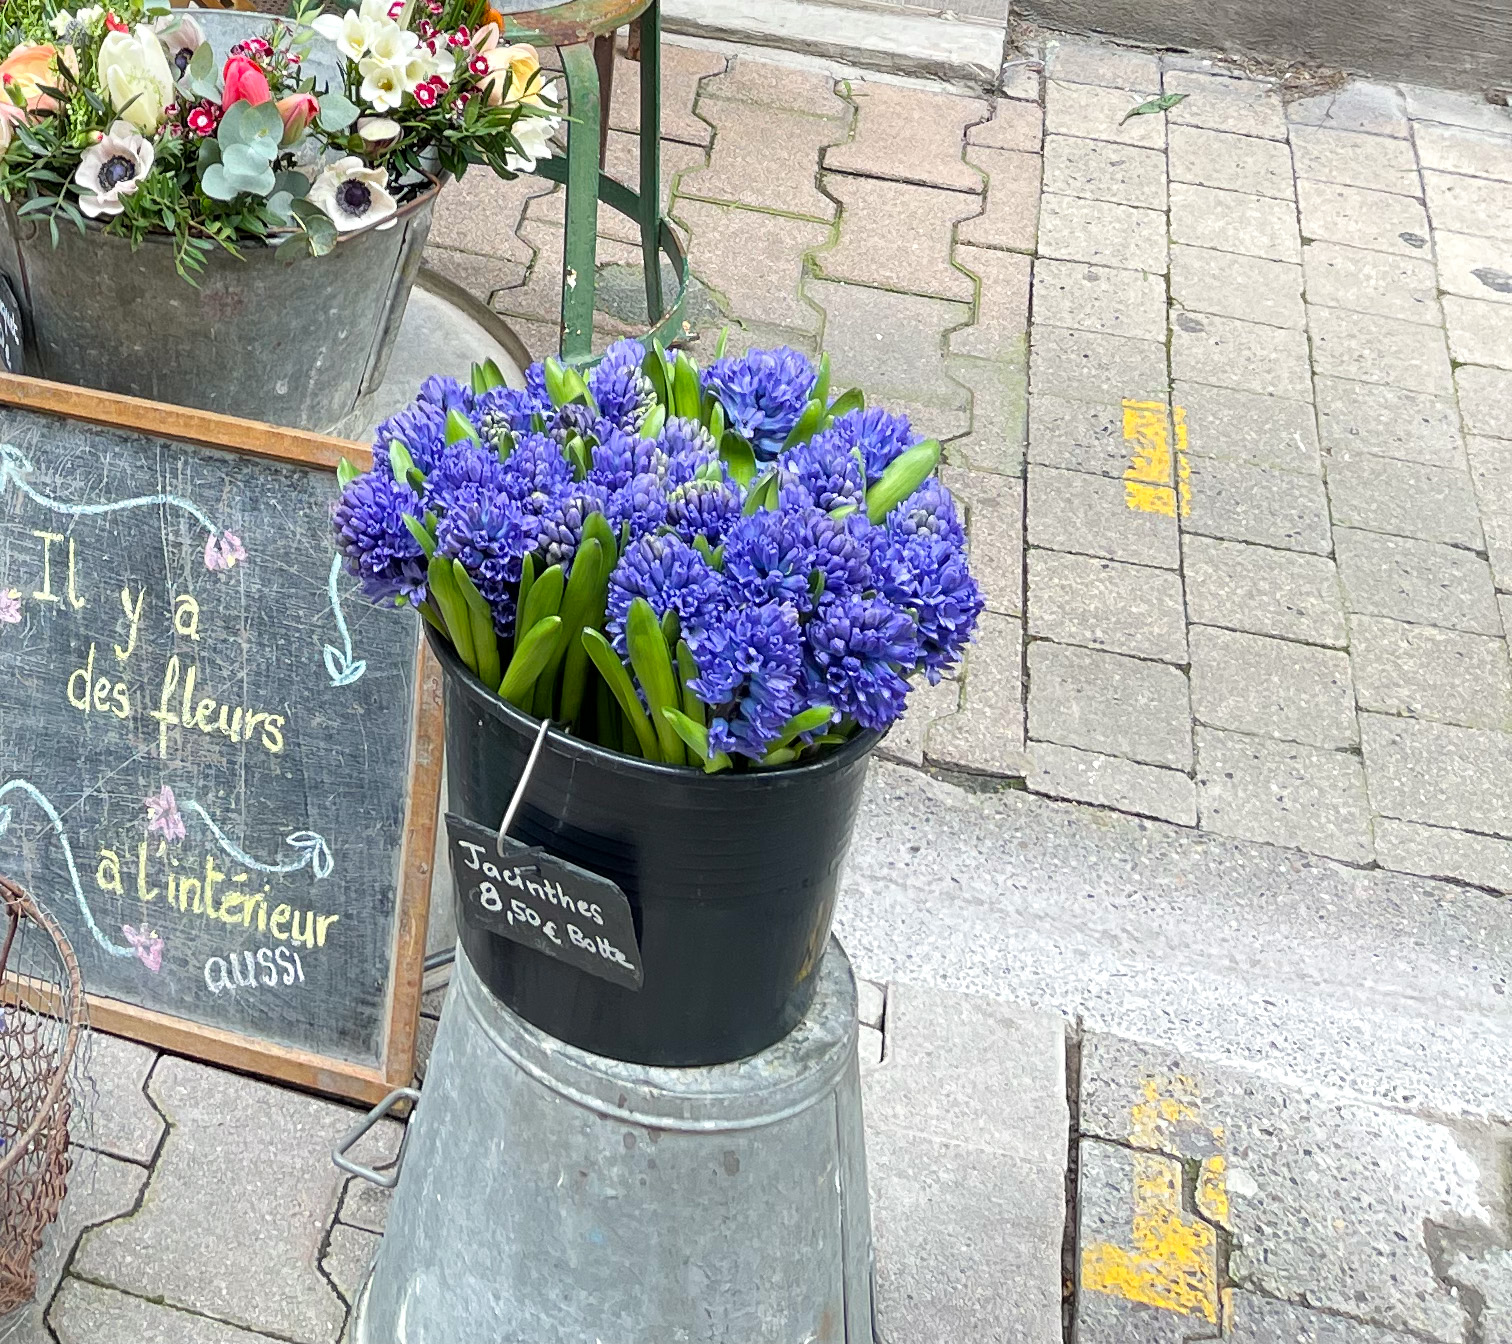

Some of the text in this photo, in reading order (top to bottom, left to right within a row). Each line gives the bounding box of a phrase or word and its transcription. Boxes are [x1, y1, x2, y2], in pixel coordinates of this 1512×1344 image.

[33, 529, 86, 610] Il
[114, 586, 201, 661] y a
[66, 642, 131, 719] des
[150, 654, 287, 759] fleurs
[458, 840, 605, 927] Jacinthes
[203, 939, 306, 995] aussi
[566, 922, 636, 971] Botte
